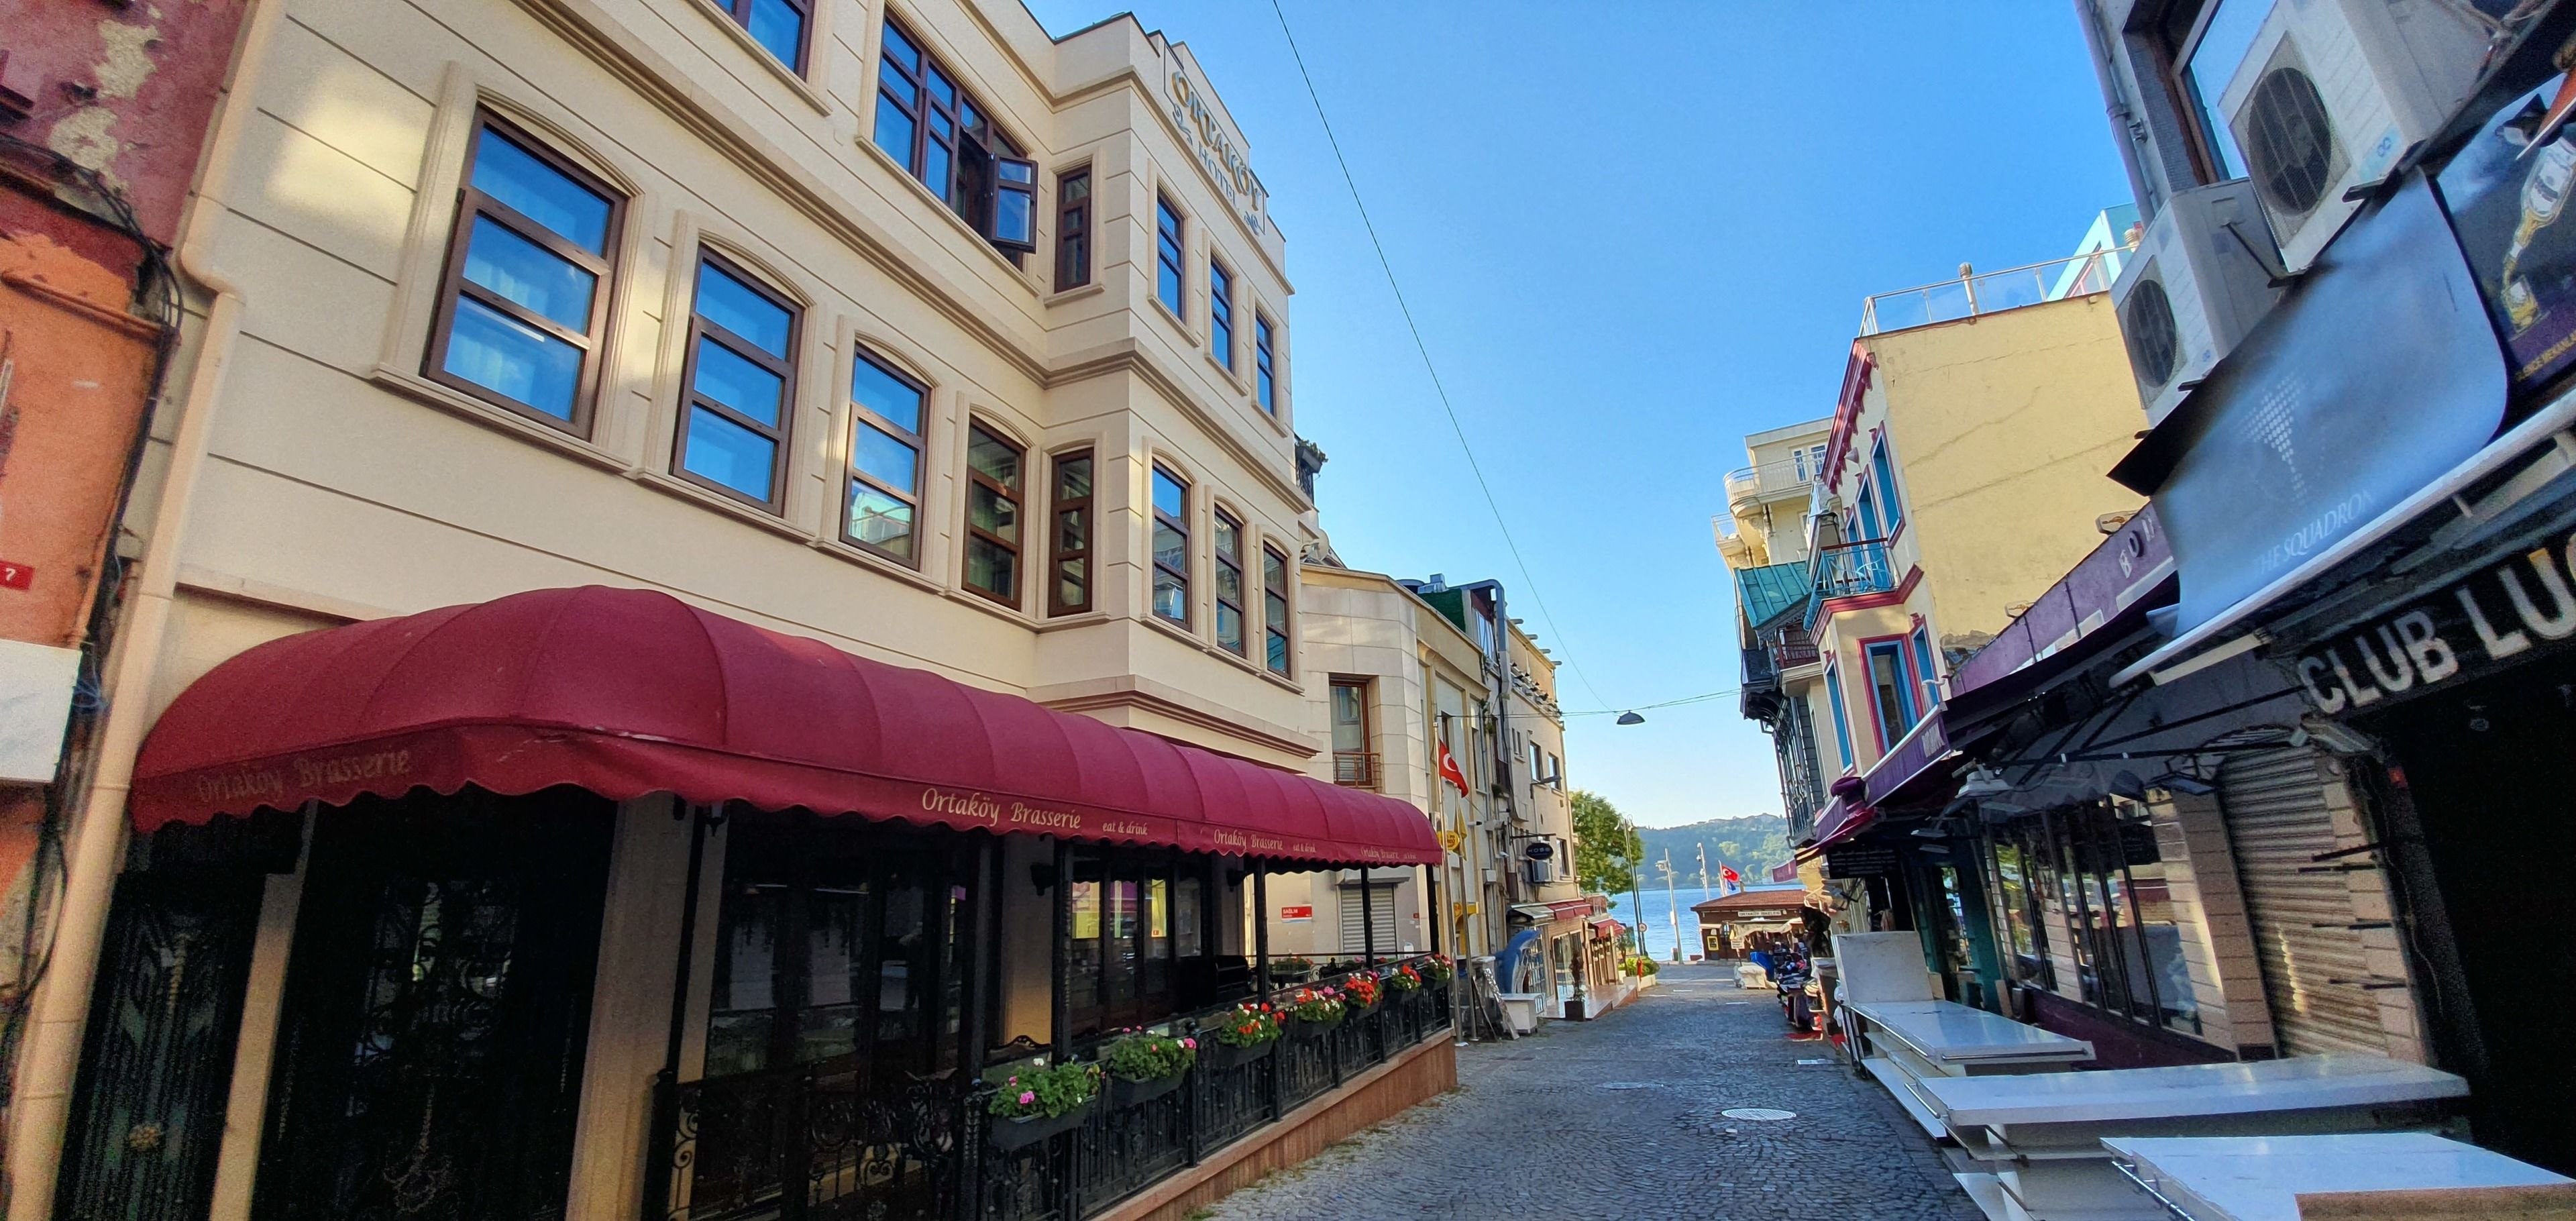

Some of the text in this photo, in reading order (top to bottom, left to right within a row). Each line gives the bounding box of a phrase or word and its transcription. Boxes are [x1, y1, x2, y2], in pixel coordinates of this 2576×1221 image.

[1171, 70, 1261, 212] ORTAKÖY
[2282, 488, 2373, 562] SQUADRON
[2298, 530, 2576, 714] CLUB LU
[293, 749, 411, 788] Brasserie
[922, 788, 1148, 836] Ortaköy Brasserie eat & drink
[1214, 829, 1247, 849] Ortaköy
[1250, 833, 1283, 851] Brasserie
